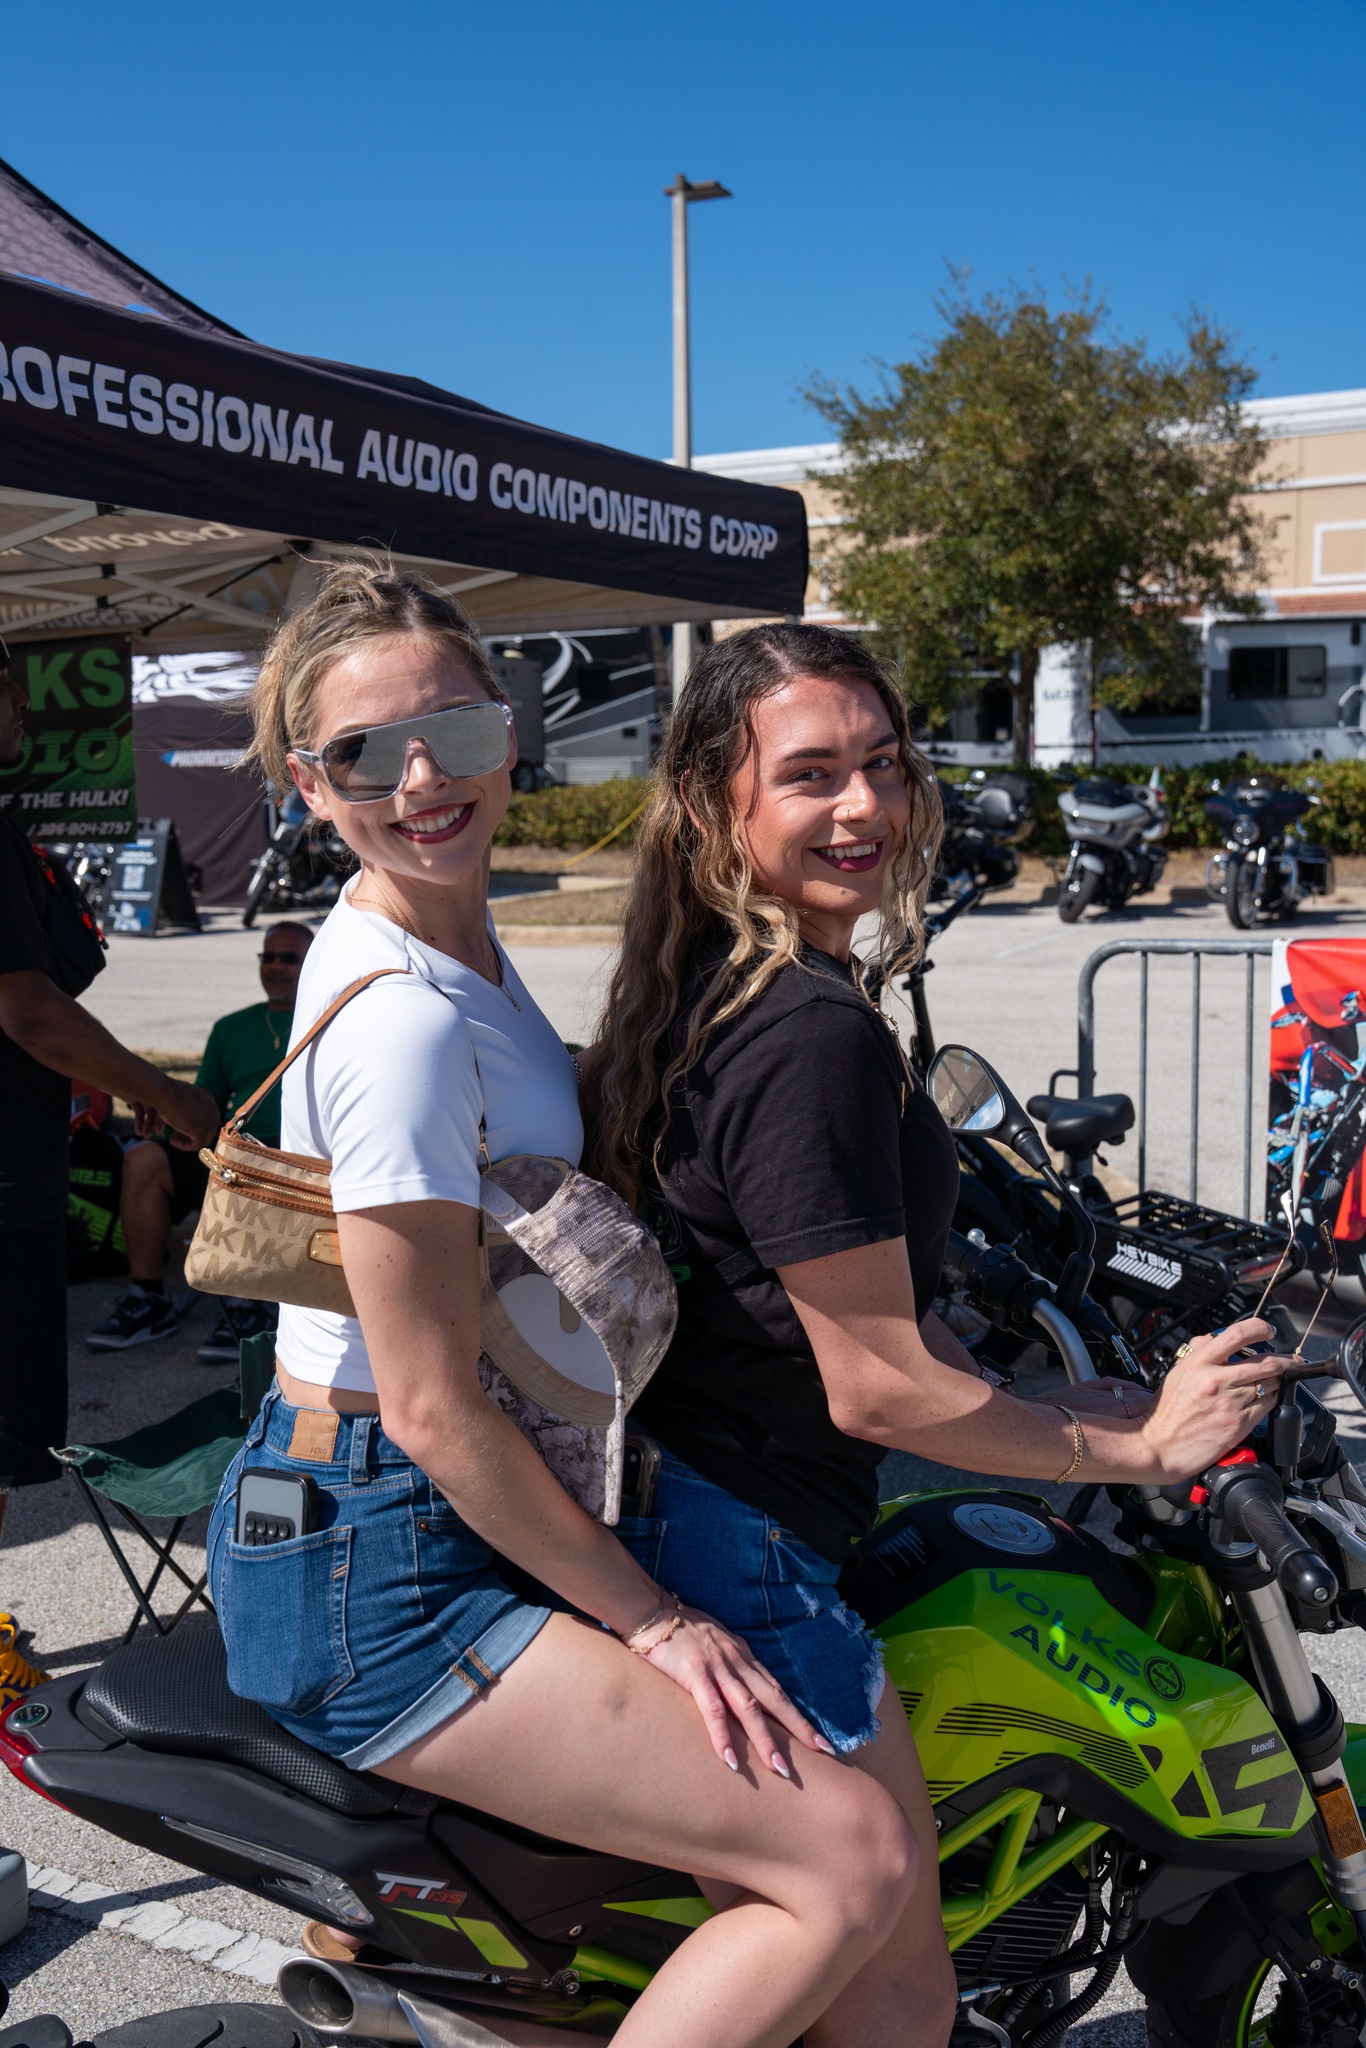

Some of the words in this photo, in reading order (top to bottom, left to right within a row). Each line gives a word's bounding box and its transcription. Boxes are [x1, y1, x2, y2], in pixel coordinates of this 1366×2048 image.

[357, 429, 479, 501] AUDIO
[489, 463, 701, 550] COMPONENTS
[709, 515, 778, 560] CORP
[27, 647, 126, 712] KS
[20, 791, 64, 810] THE
[69, 788, 129, 808] HULK!
[1116, 1240, 1183, 1277] HEYBIKE
[310, 1446, 328, 1455] AERO
[988, 1570, 1142, 1677] VOLKS
[1009, 1623, 1157, 1729] AUDIO
[1251, 1737, 1275, 1755] Benelli
